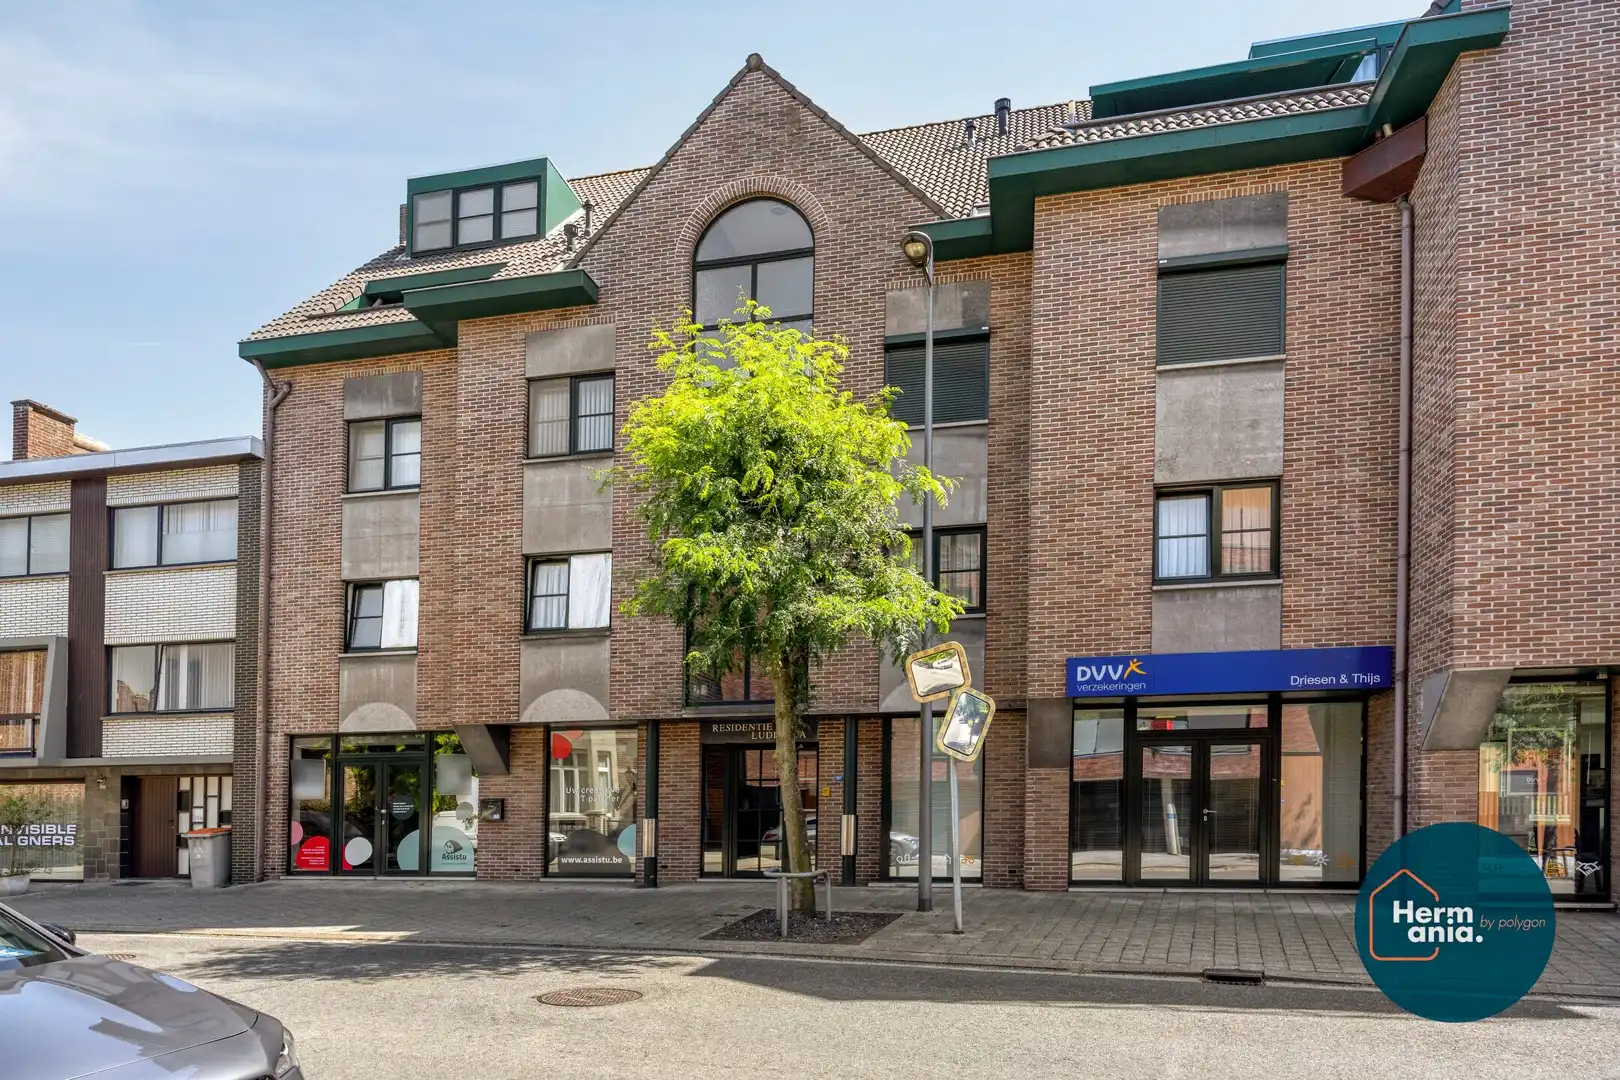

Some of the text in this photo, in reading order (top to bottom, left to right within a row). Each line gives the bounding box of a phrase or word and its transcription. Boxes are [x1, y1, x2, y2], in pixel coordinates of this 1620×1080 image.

[1077, 664, 1123, 681] DVV
[1290, 672, 1381, 686] Driesen & Thijs
[1077, 681, 1147, 692] verzekeringen
[712, 723, 773, 732] RESIDENTIE
[0, 835, 75, 846] LGNERS
[561, 856, 623, 864] www.assistu.be
